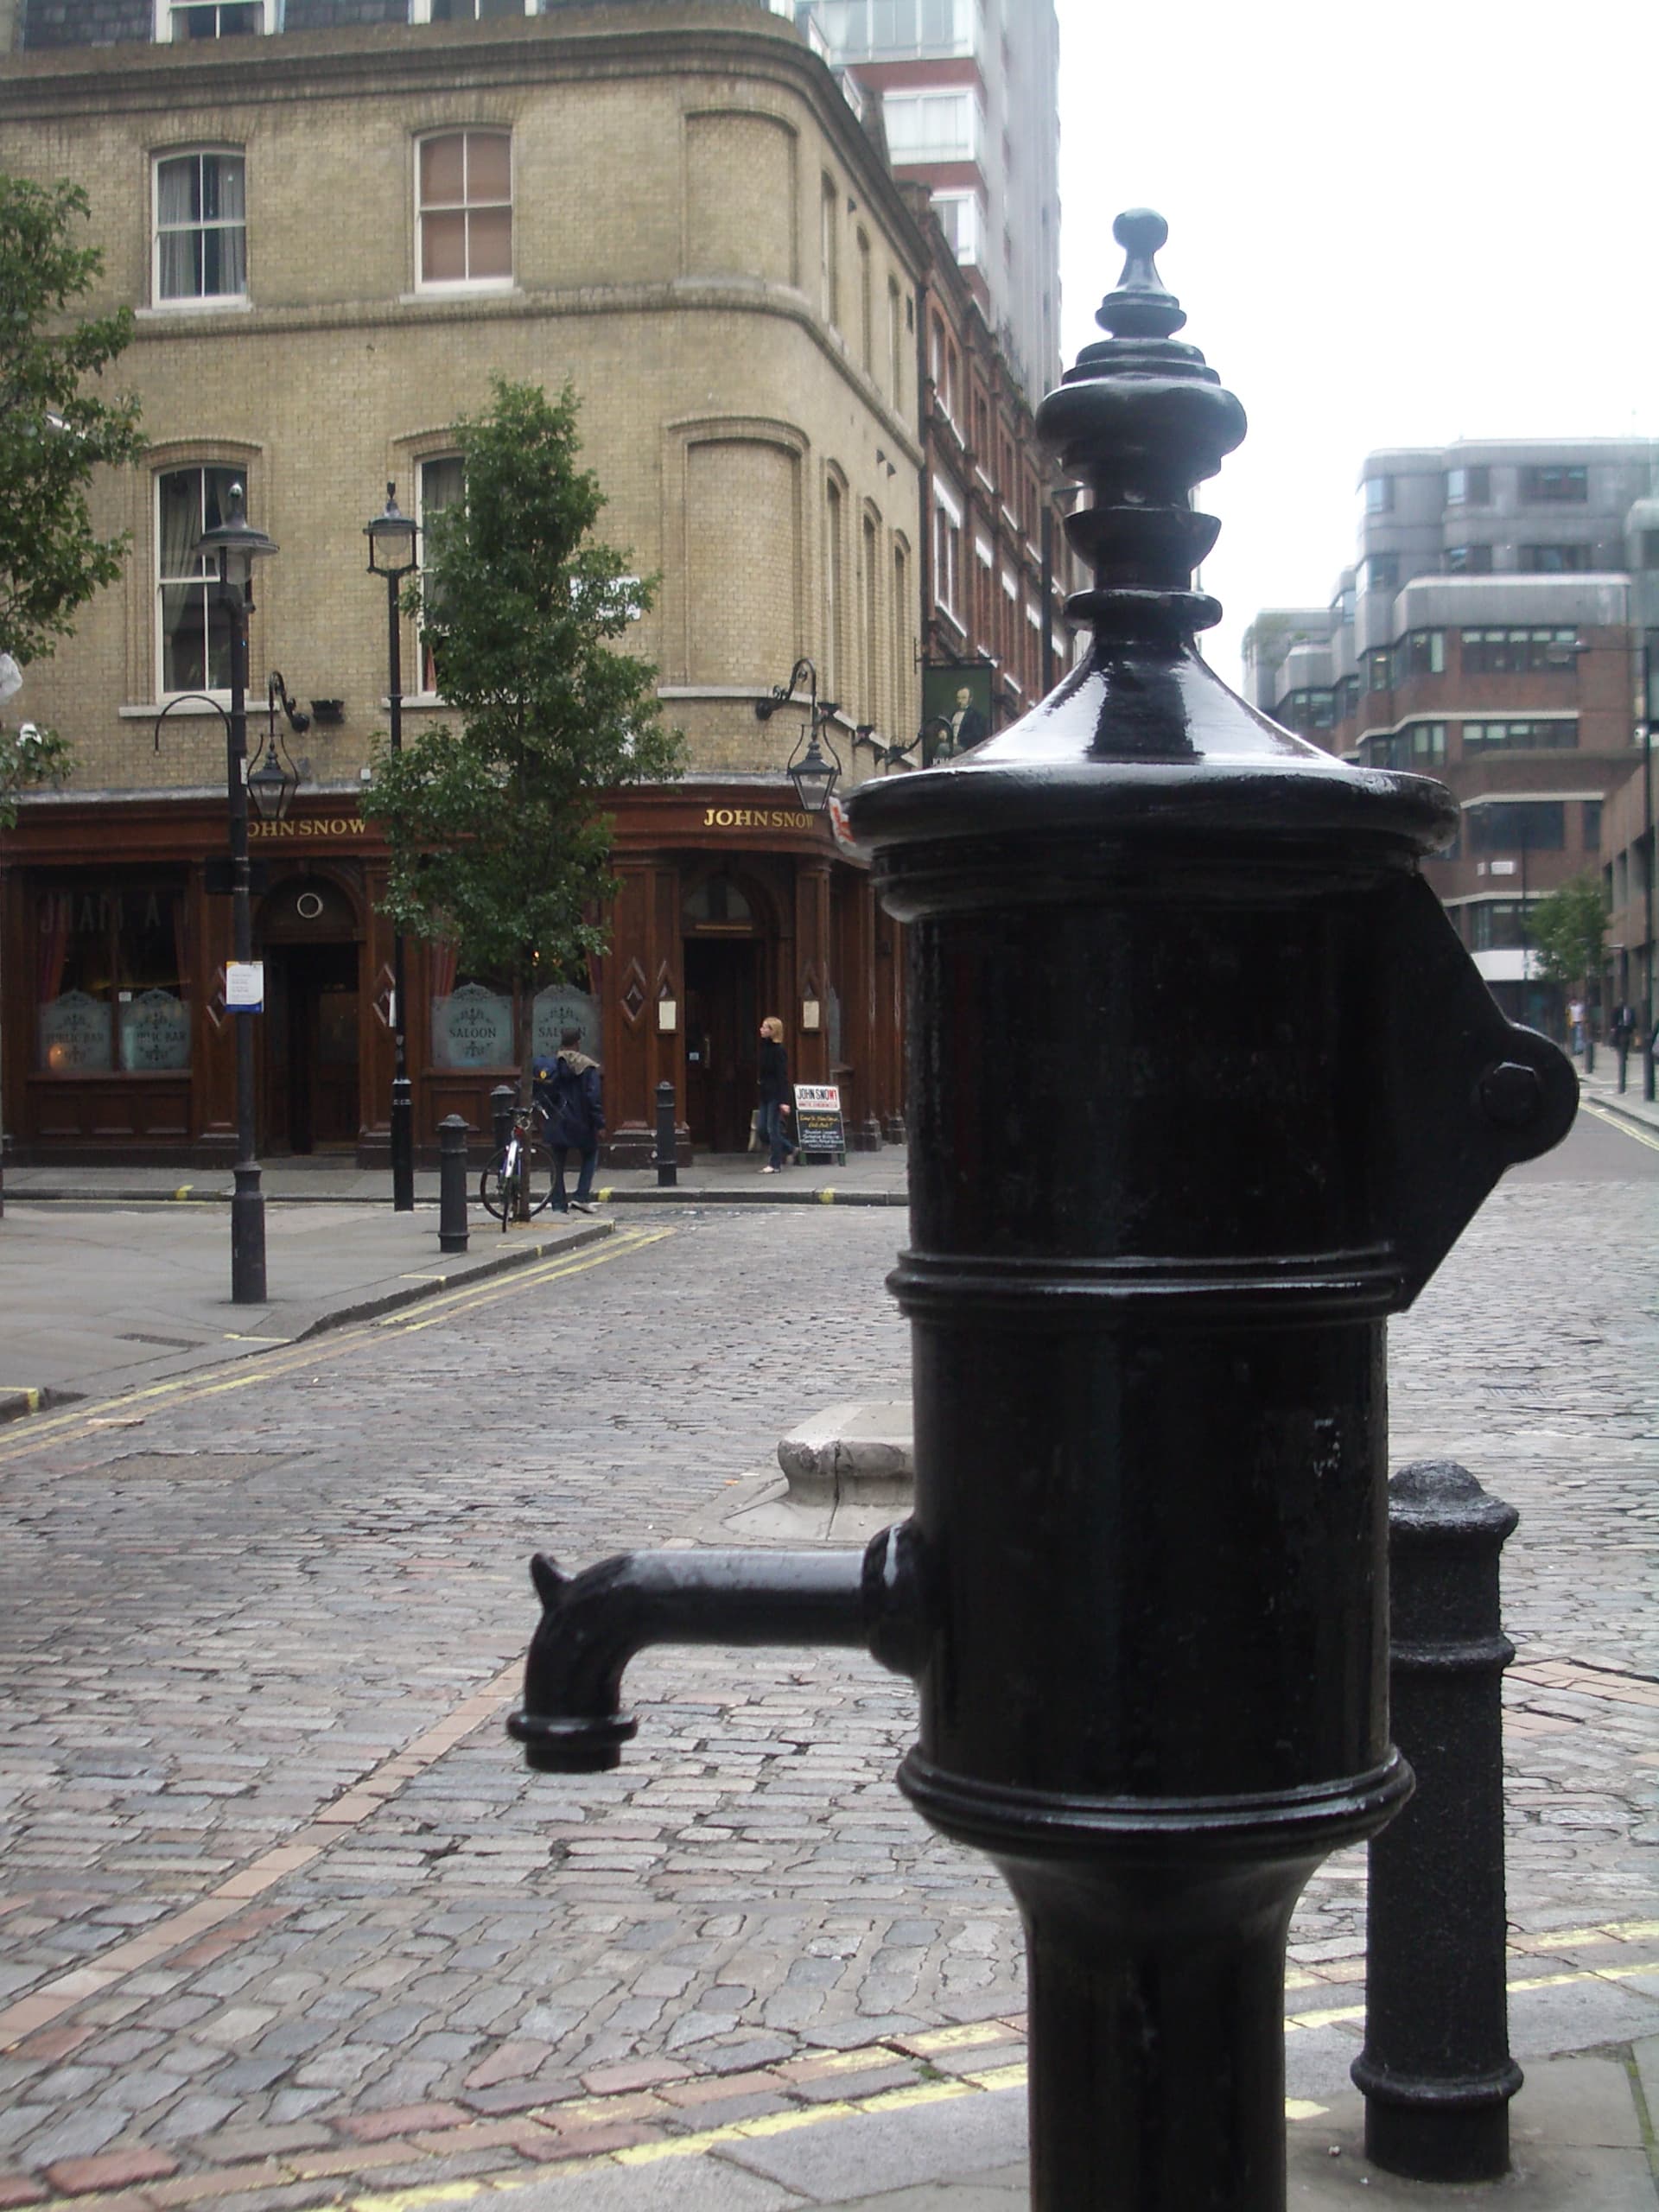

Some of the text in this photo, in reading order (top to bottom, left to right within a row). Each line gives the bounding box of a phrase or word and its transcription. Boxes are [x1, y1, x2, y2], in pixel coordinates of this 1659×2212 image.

[703, 809, 767, 826] JOHN
[772, 811, 815, 830] SNOW
[247, 818, 366, 837] OHN SNOW
[448, 1027, 497, 1038] SALOON
[538, 1027, 586, 1037] SALN
